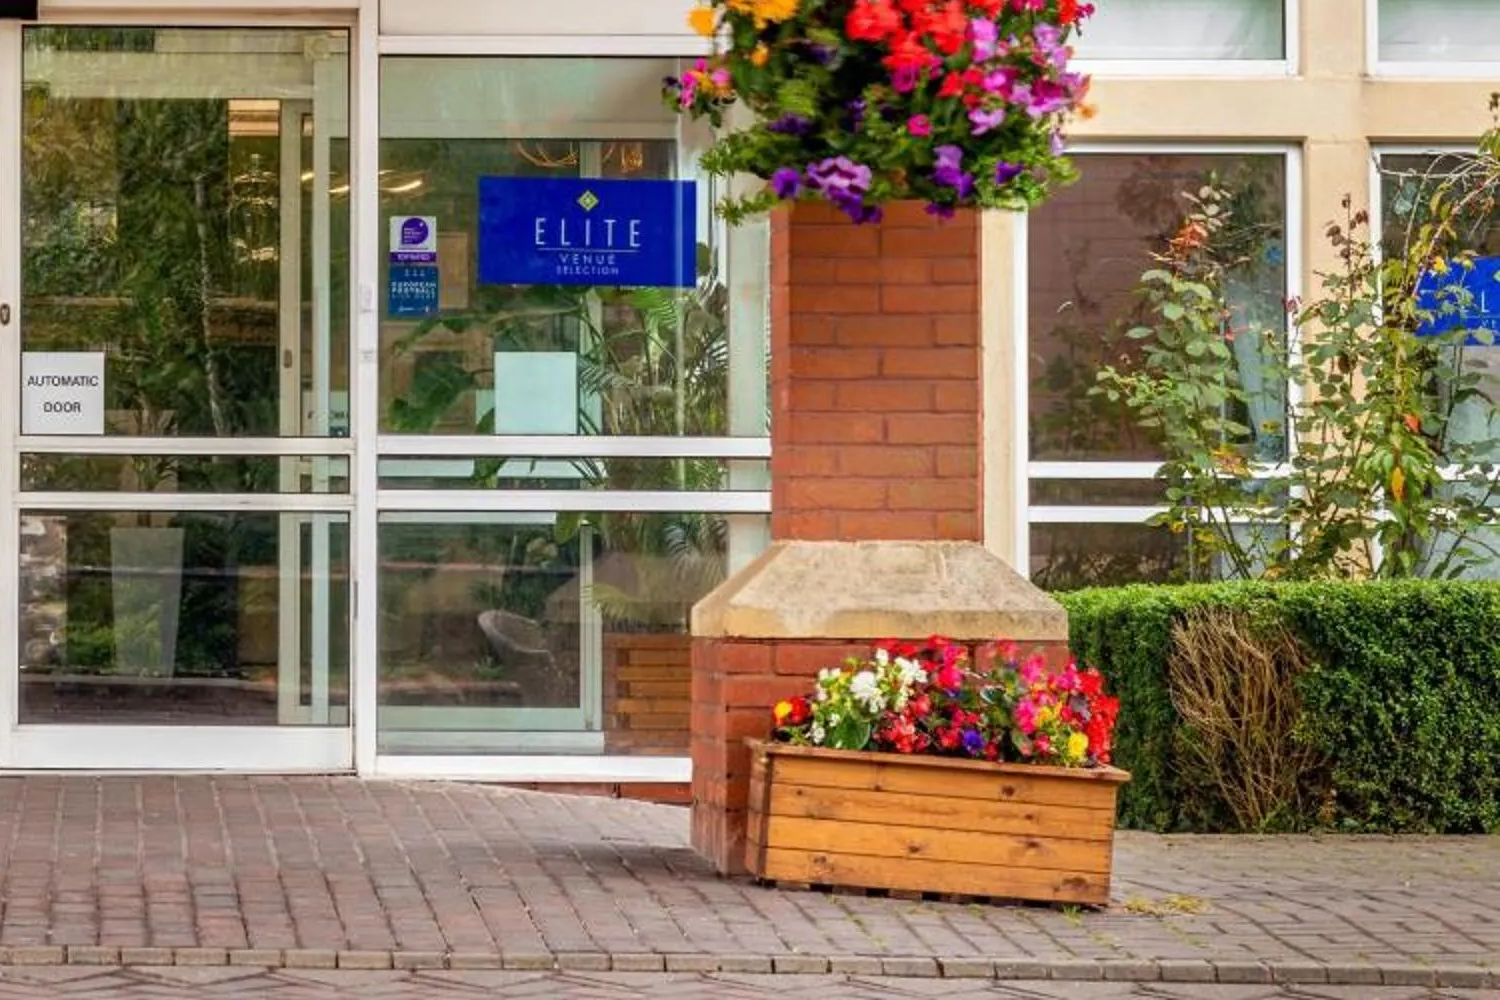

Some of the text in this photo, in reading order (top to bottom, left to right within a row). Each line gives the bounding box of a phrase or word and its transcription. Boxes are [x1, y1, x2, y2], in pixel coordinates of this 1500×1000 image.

[535, 217, 641, 247] ELITE
[559, 253, 616, 265] VENUE
[556, 265, 619, 276] SELECTION
[26, 375, 100, 388] AUTOMATIC
[43, 402, 82, 414] DOOR
